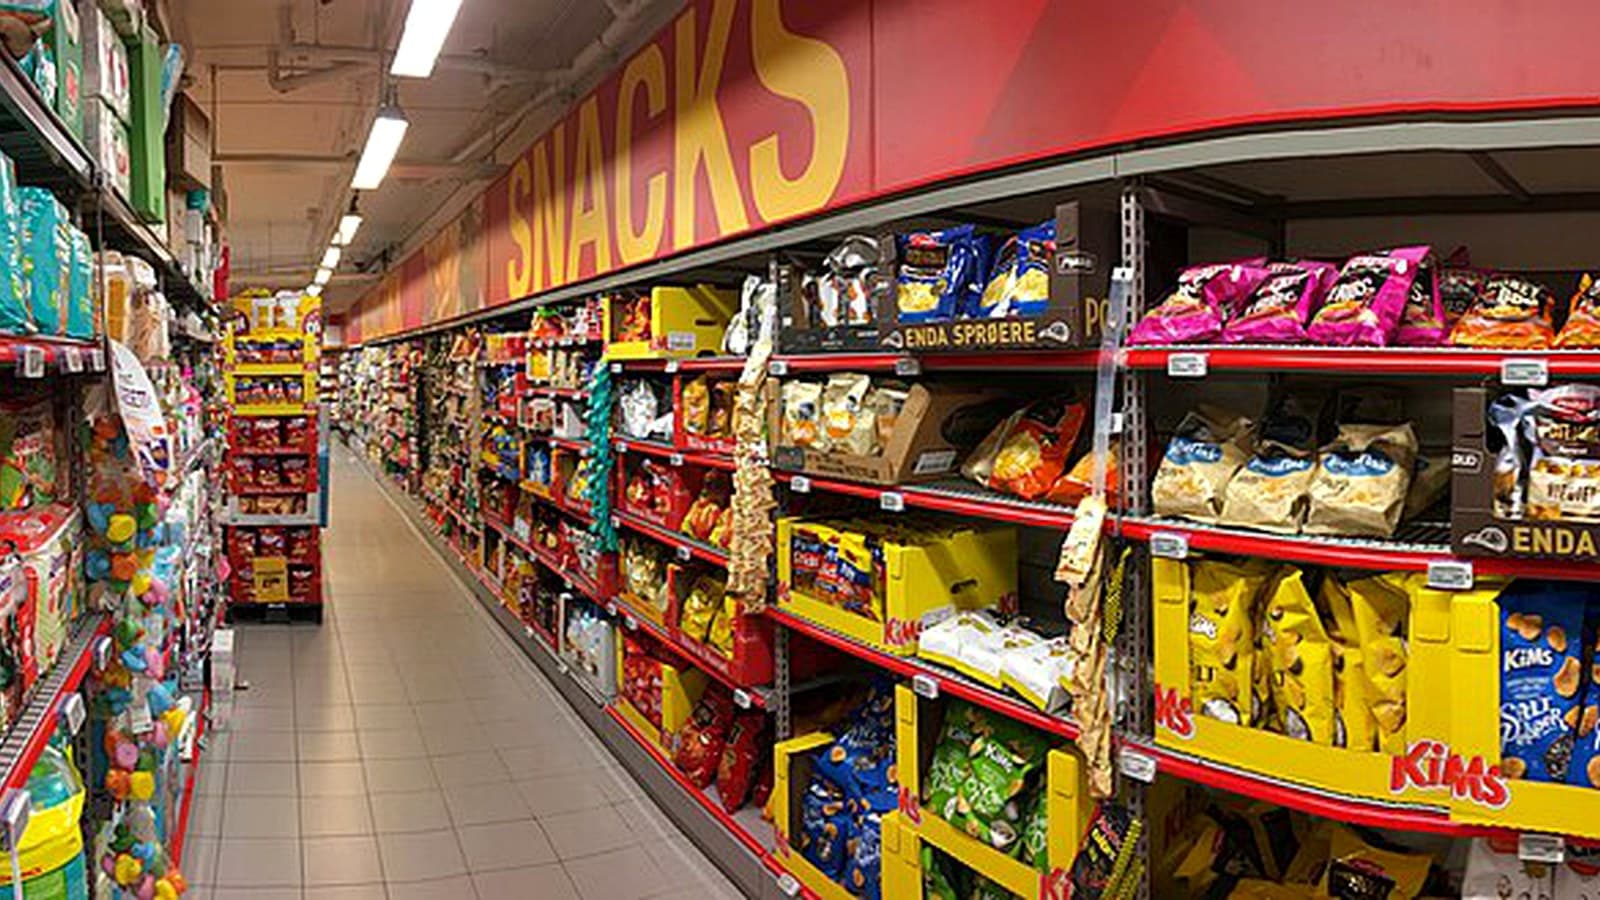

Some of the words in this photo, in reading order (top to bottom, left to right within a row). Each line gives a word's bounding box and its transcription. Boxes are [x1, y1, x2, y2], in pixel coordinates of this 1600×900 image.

[508, 0, 850, 299] SNACKS
[905, 327, 949, 347] ENDA
[953, 321, 1036, 345] SPRØERE
[1513, 526, 1598, 556] ENDA
[1504, 646, 1553, 672] KiMs
[1390, 740, 1509, 806] KiMs
